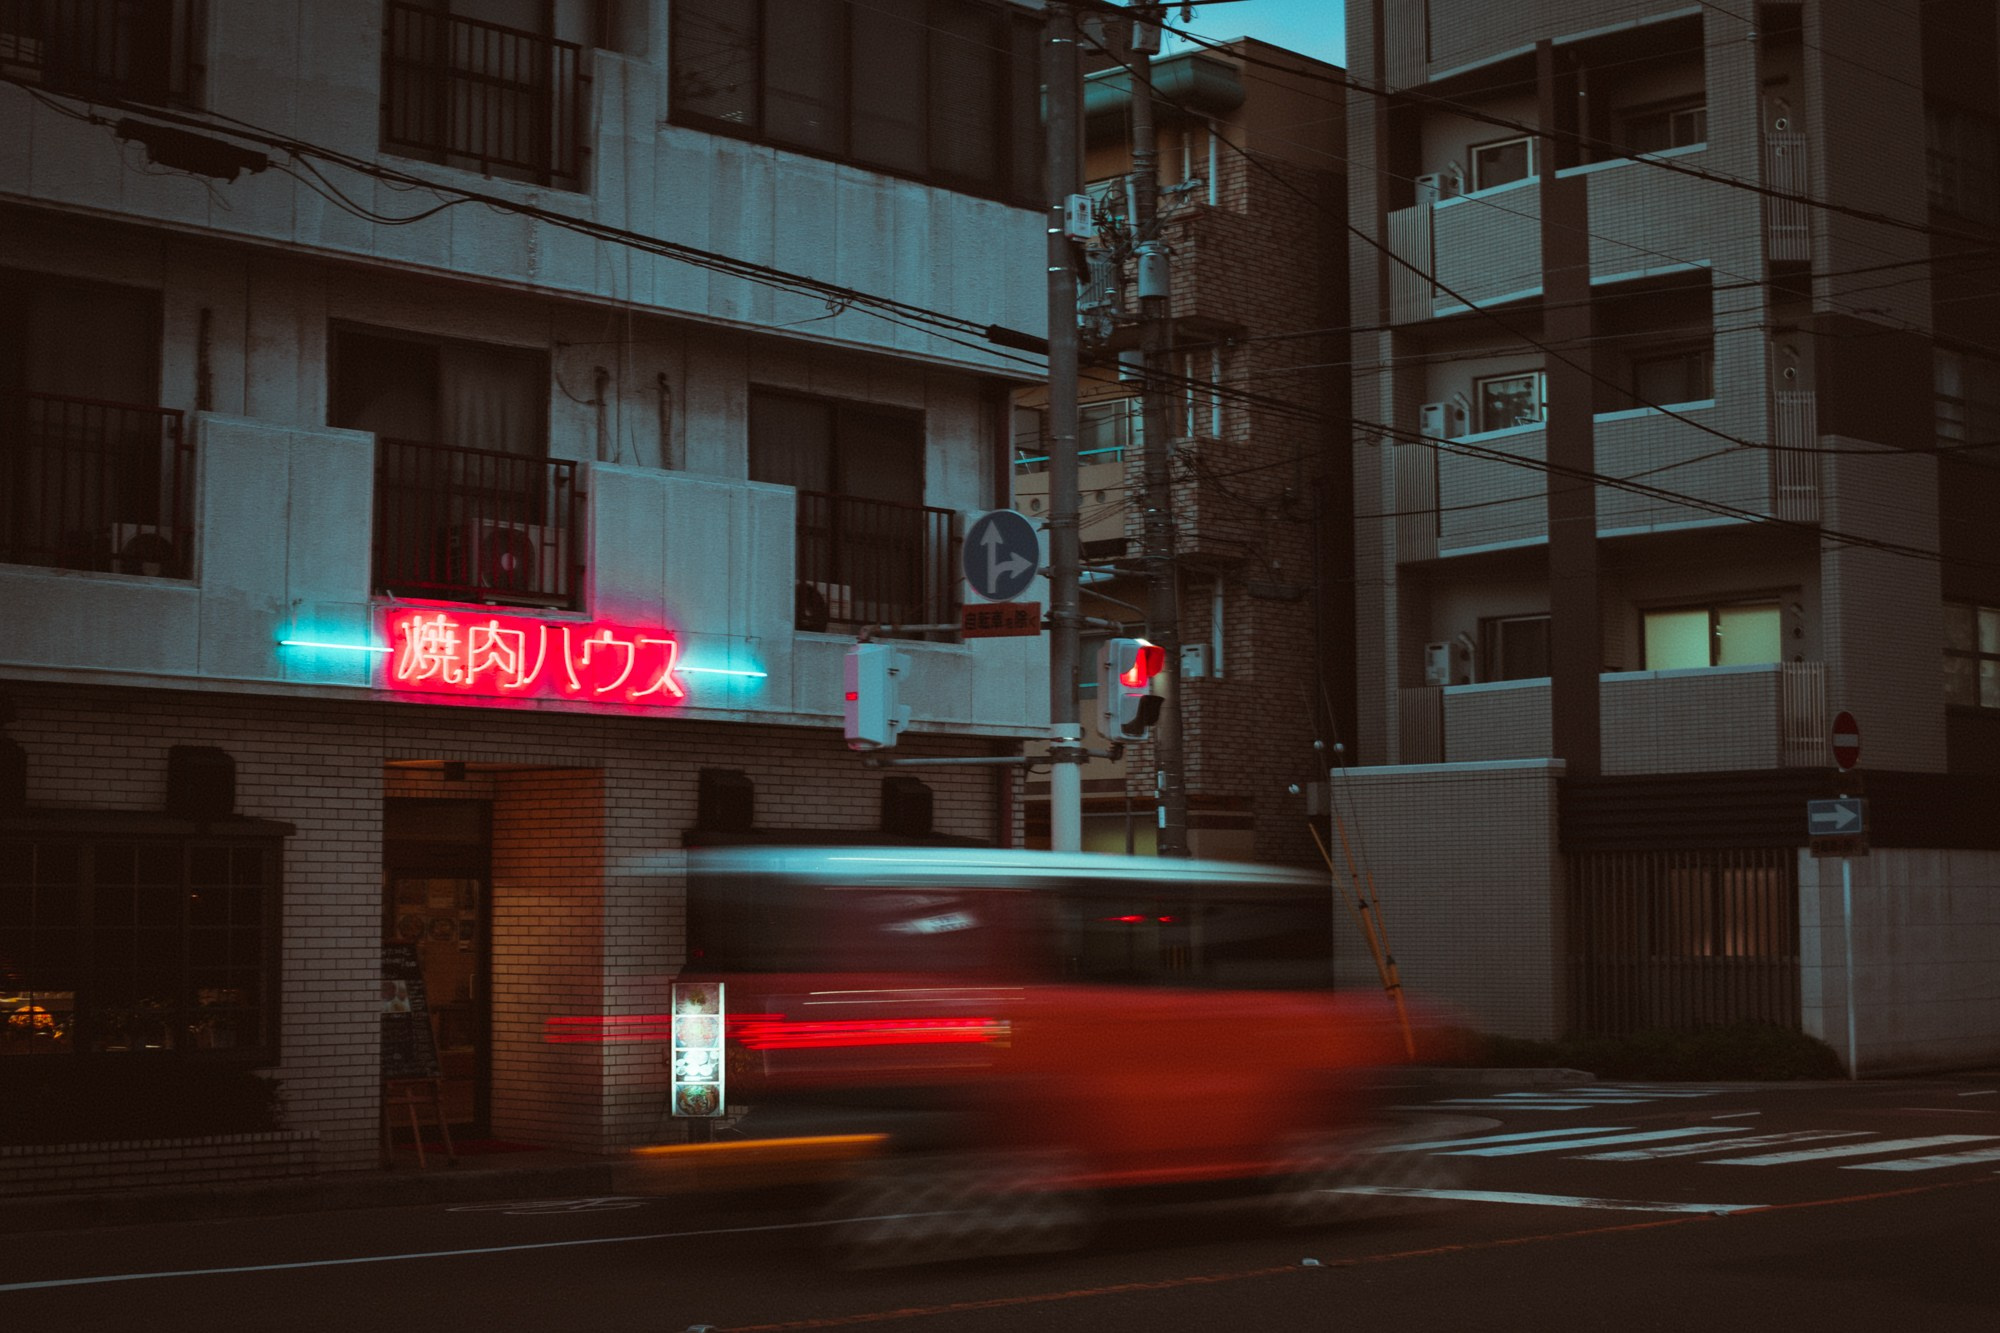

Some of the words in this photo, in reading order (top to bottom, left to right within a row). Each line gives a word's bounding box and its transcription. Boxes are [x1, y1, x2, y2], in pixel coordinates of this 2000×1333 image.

[397, 614, 685, 698] 焼肉ハウス
